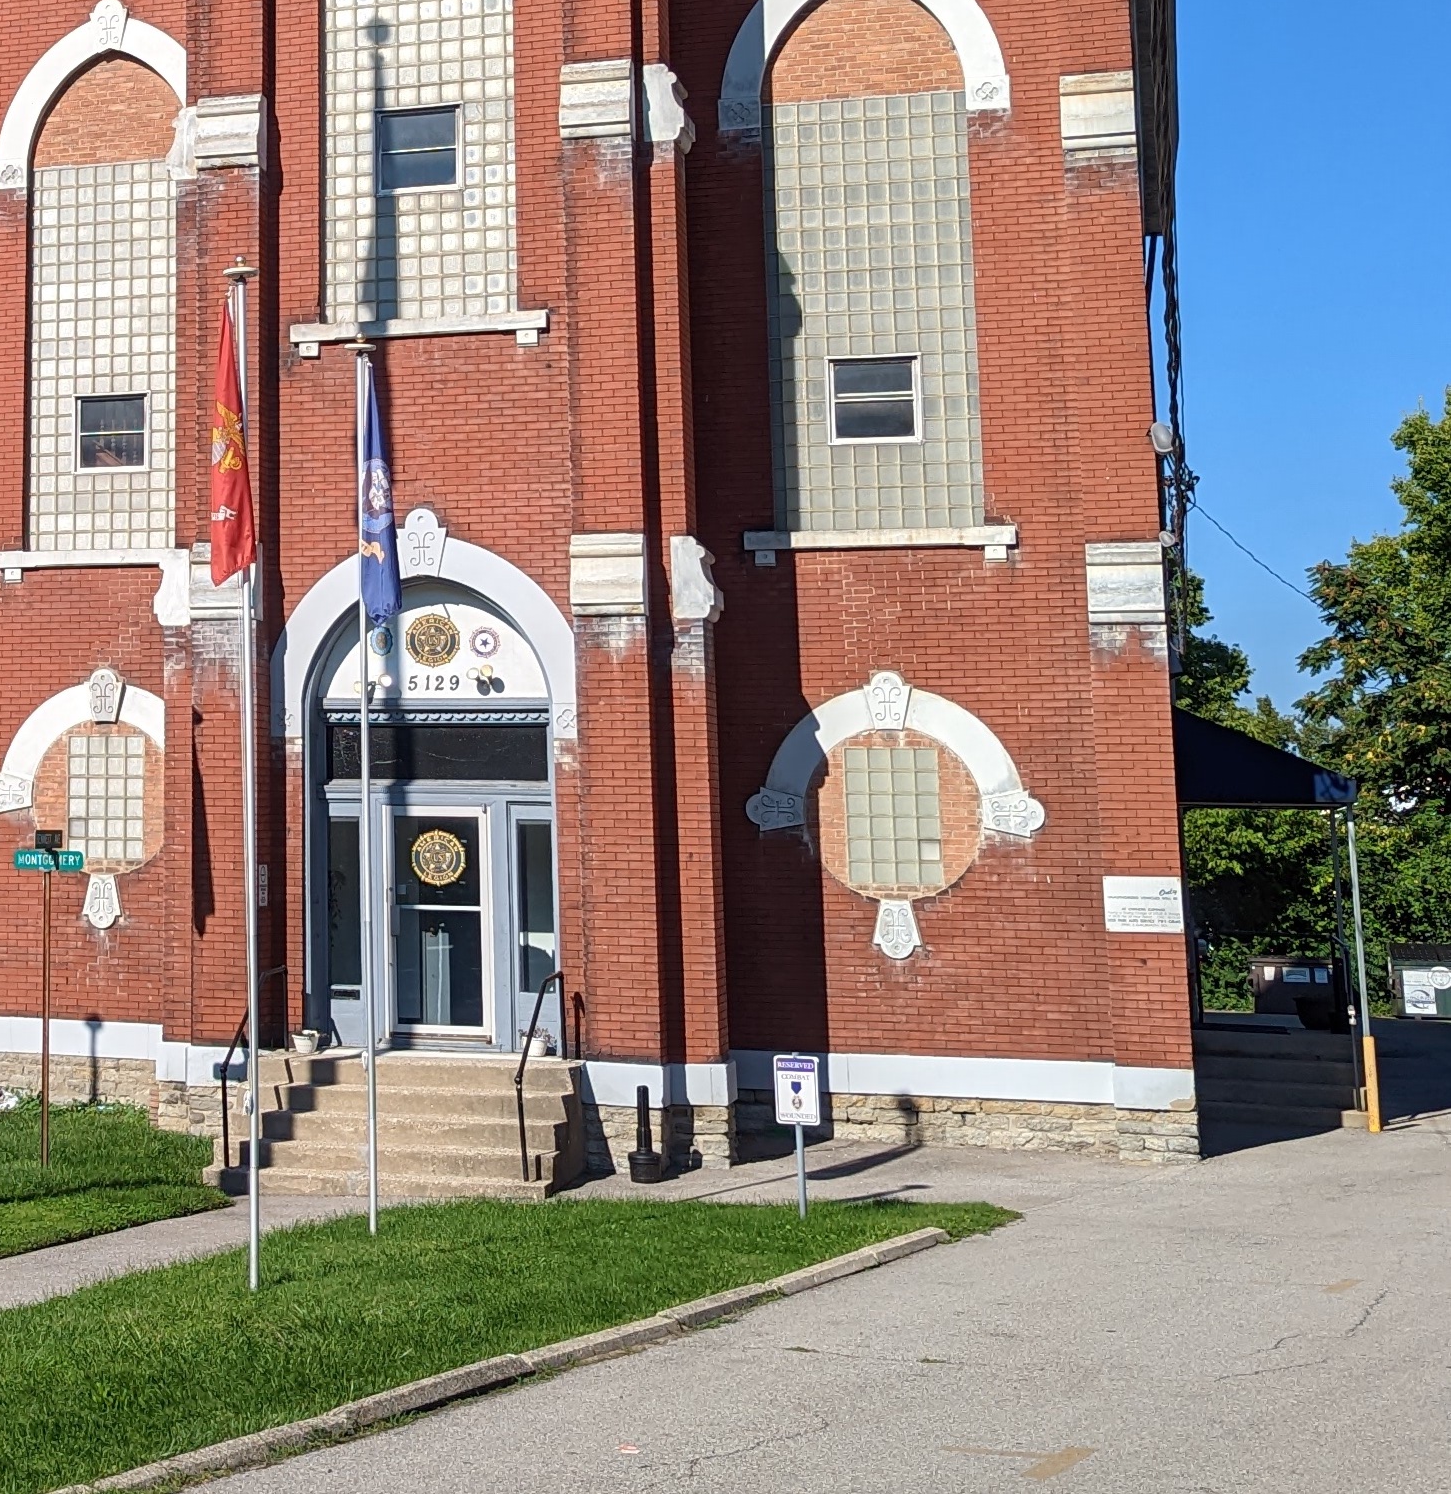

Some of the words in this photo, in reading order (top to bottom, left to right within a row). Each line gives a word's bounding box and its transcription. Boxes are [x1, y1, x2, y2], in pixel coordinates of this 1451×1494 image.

[408, 674, 460, 691] 5129
[777, 1061, 814, 1069] RESERVED
[780, 1112, 816, 1120] WOUNDED
